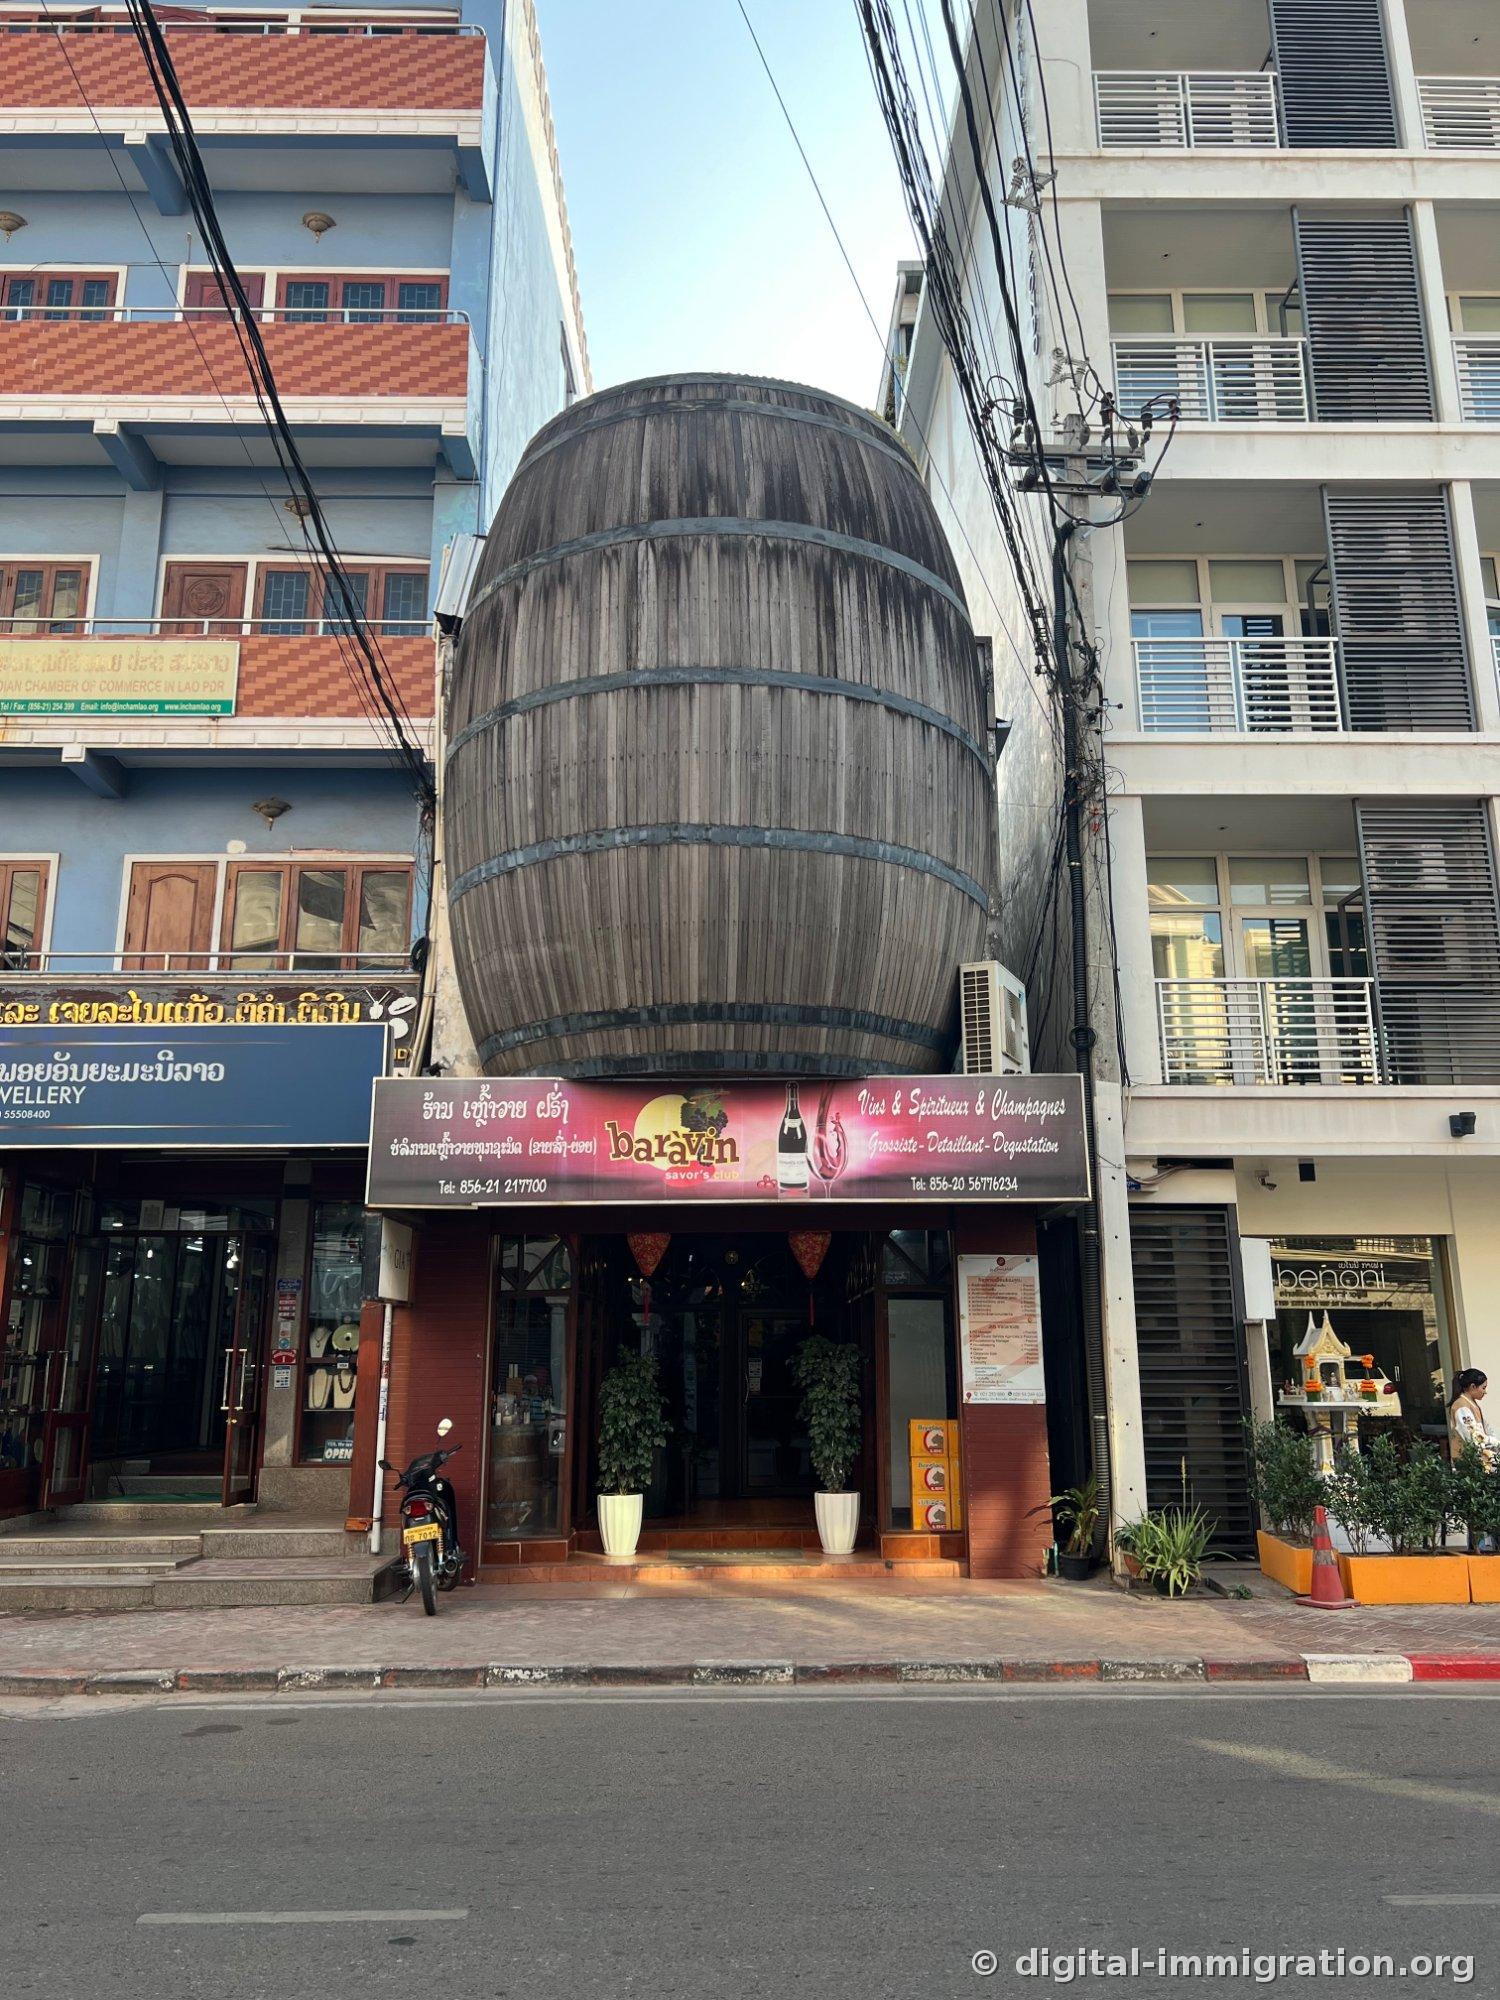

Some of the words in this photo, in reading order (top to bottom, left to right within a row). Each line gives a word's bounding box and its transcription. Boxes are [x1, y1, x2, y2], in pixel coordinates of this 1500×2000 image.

[25, 680, 78, 692] CHAMBER
[82, 680, 96, 692] OF
[100, 680, 161, 692] COMMERCE
[164, 680, 175, 692] IN
[177, 680, 199, 692] LAO
[202, 680, 224, 692] PDR
[27, 702, 51, 711] (856-21)
[80, 702, 99, 711] Email:
[857, 1088, 886, 1116] Vins
[891, 1089, 902, 1116] &
[908, 1087, 970, 1122] Spiritueux
[975, 1089, 985, 1116] &
[991, 1087, 1067, 1125] Champagnes
[3, 1109, 51, 1120] 55508400
[712, 1169, 740, 1180] club
[439, 1179, 456, 1194] Tel:
[460, 1179, 500, 1194] 856-21
[504, 1178, 547, 1194] 217700
[911, 1176, 926, 1191] Tel:
[929, 1176, 965, 1191] 856-20
[969, 1176, 1018, 1191] 56776234
[1277, 1263, 1385, 1289] benoni
[324, 1448, 353, 1459] OPEN
